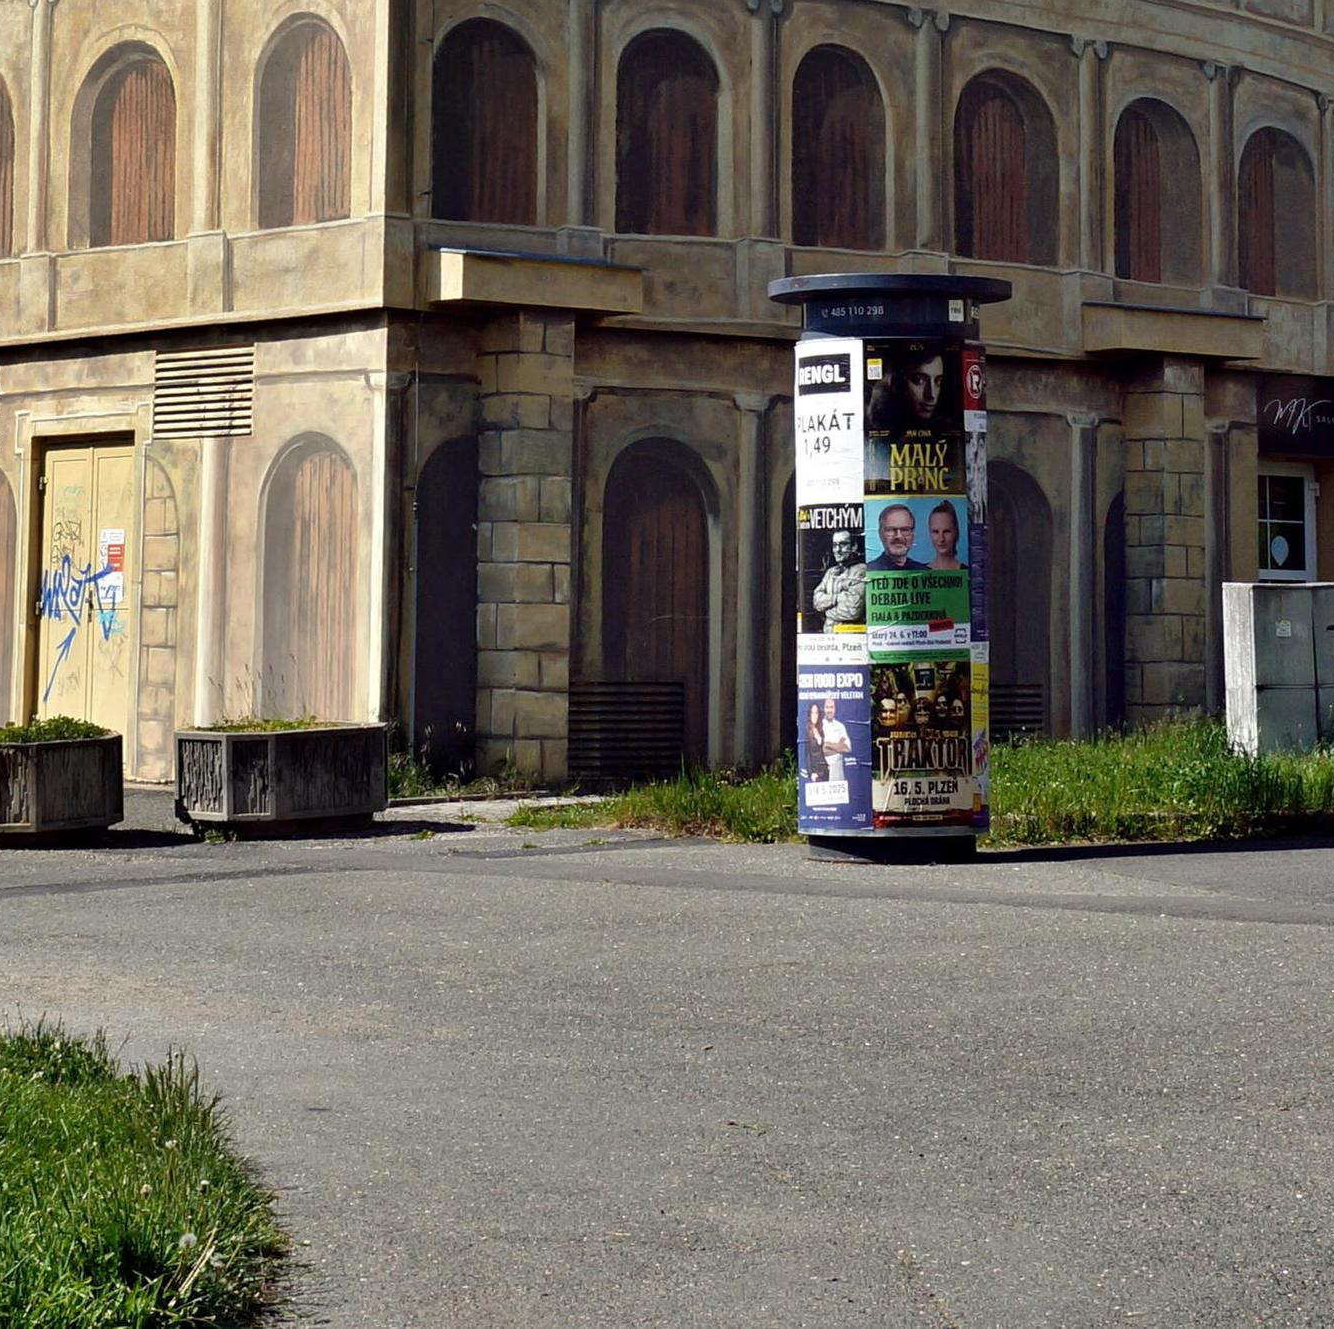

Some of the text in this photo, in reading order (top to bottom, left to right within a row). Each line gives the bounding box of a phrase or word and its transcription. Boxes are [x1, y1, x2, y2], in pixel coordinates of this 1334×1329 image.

[830, 305, 884, 317] 485 110 298
[798, 364, 846, 385] RENGL
[890, 439, 948, 468] MALÝ
[890, 467, 949, 491] PRINC
[809, 504, 863, 529] VETCHÝM
[892, 576, 909, 589] JDE
[912, 576, 919, 589] O
[871, 592, 931, 606] DEBATA LIVE
[836, 672, 863, 688] EXPO
[894, 777, 959, 795] 16. 5. PLZEŇ
